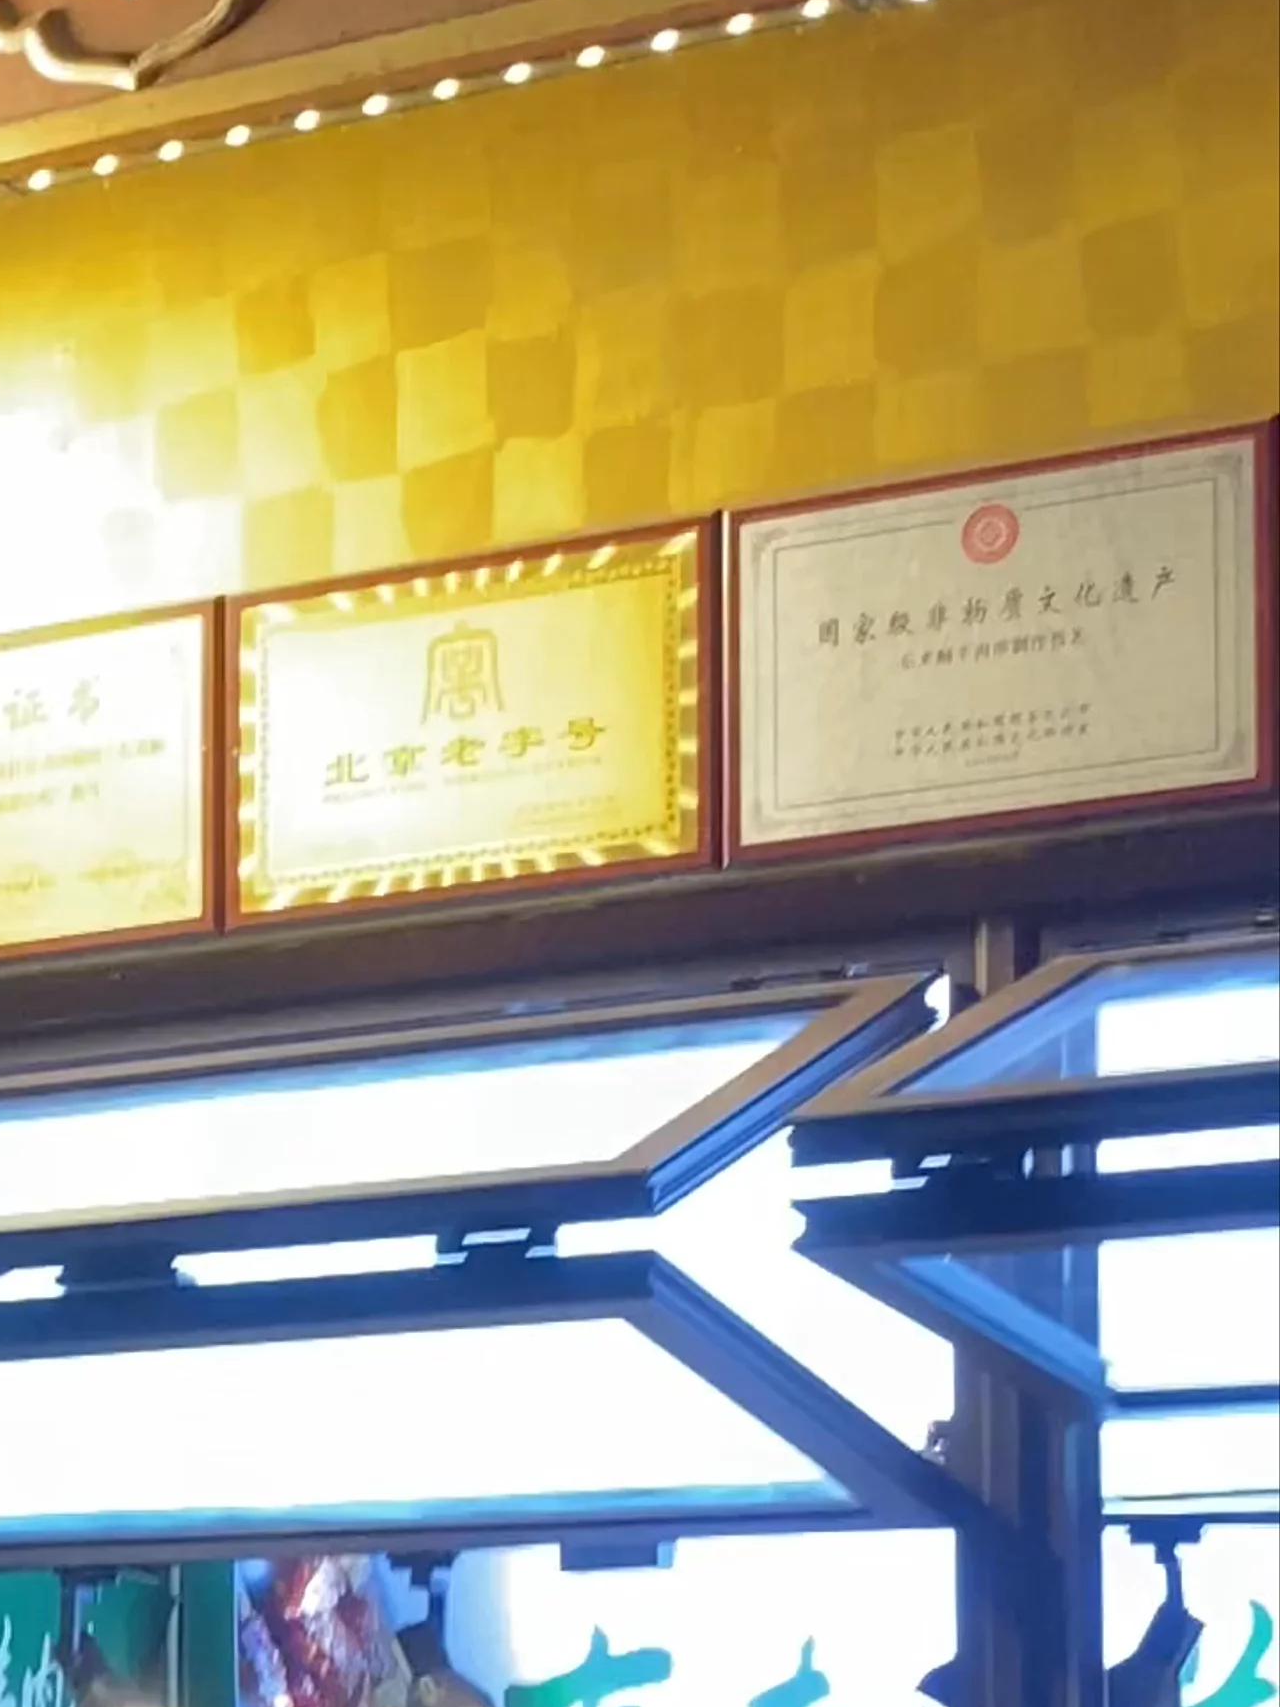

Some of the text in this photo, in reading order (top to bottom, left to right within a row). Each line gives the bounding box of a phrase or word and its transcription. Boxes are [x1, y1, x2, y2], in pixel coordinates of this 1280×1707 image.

[322, 715, 608, 790] 北京老字号
